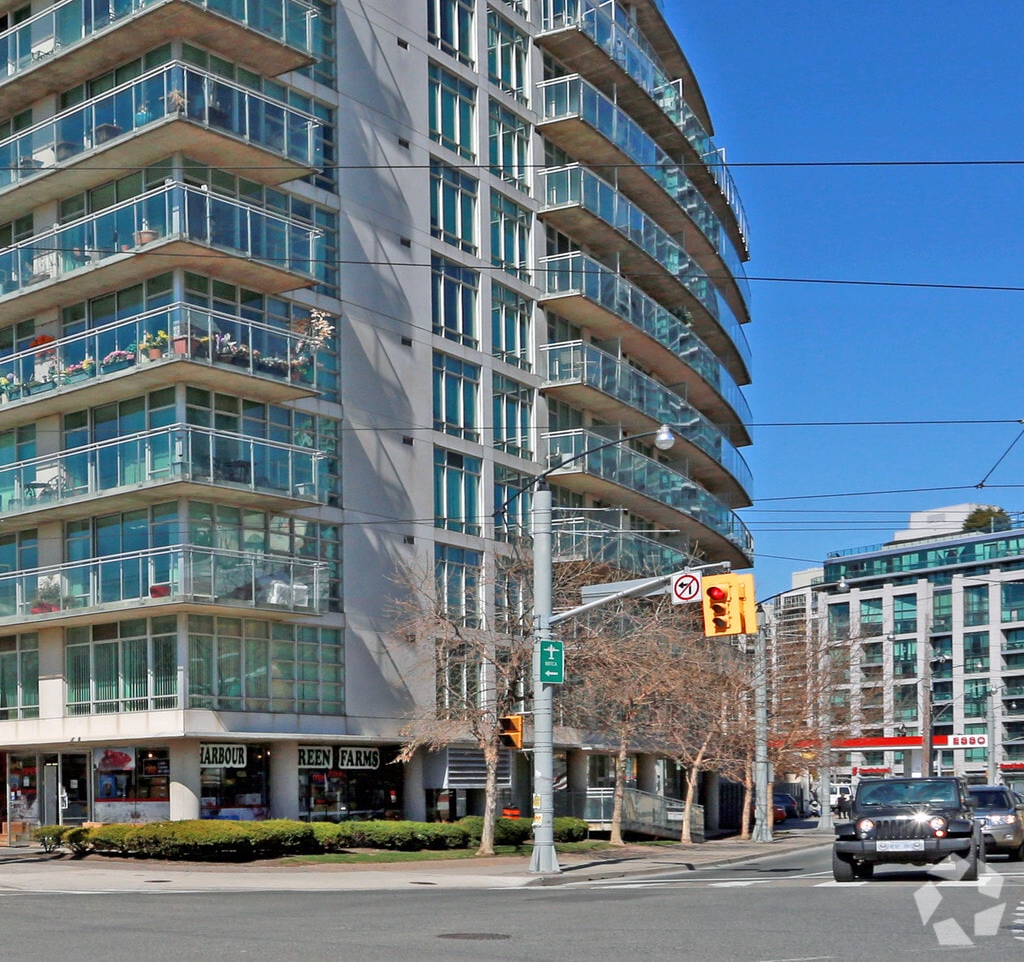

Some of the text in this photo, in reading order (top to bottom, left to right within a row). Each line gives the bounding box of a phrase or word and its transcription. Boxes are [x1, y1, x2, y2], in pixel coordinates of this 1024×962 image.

[953, 736, 986, 745] ESSO
[298, 749, 378, 768] REEN FARMS
